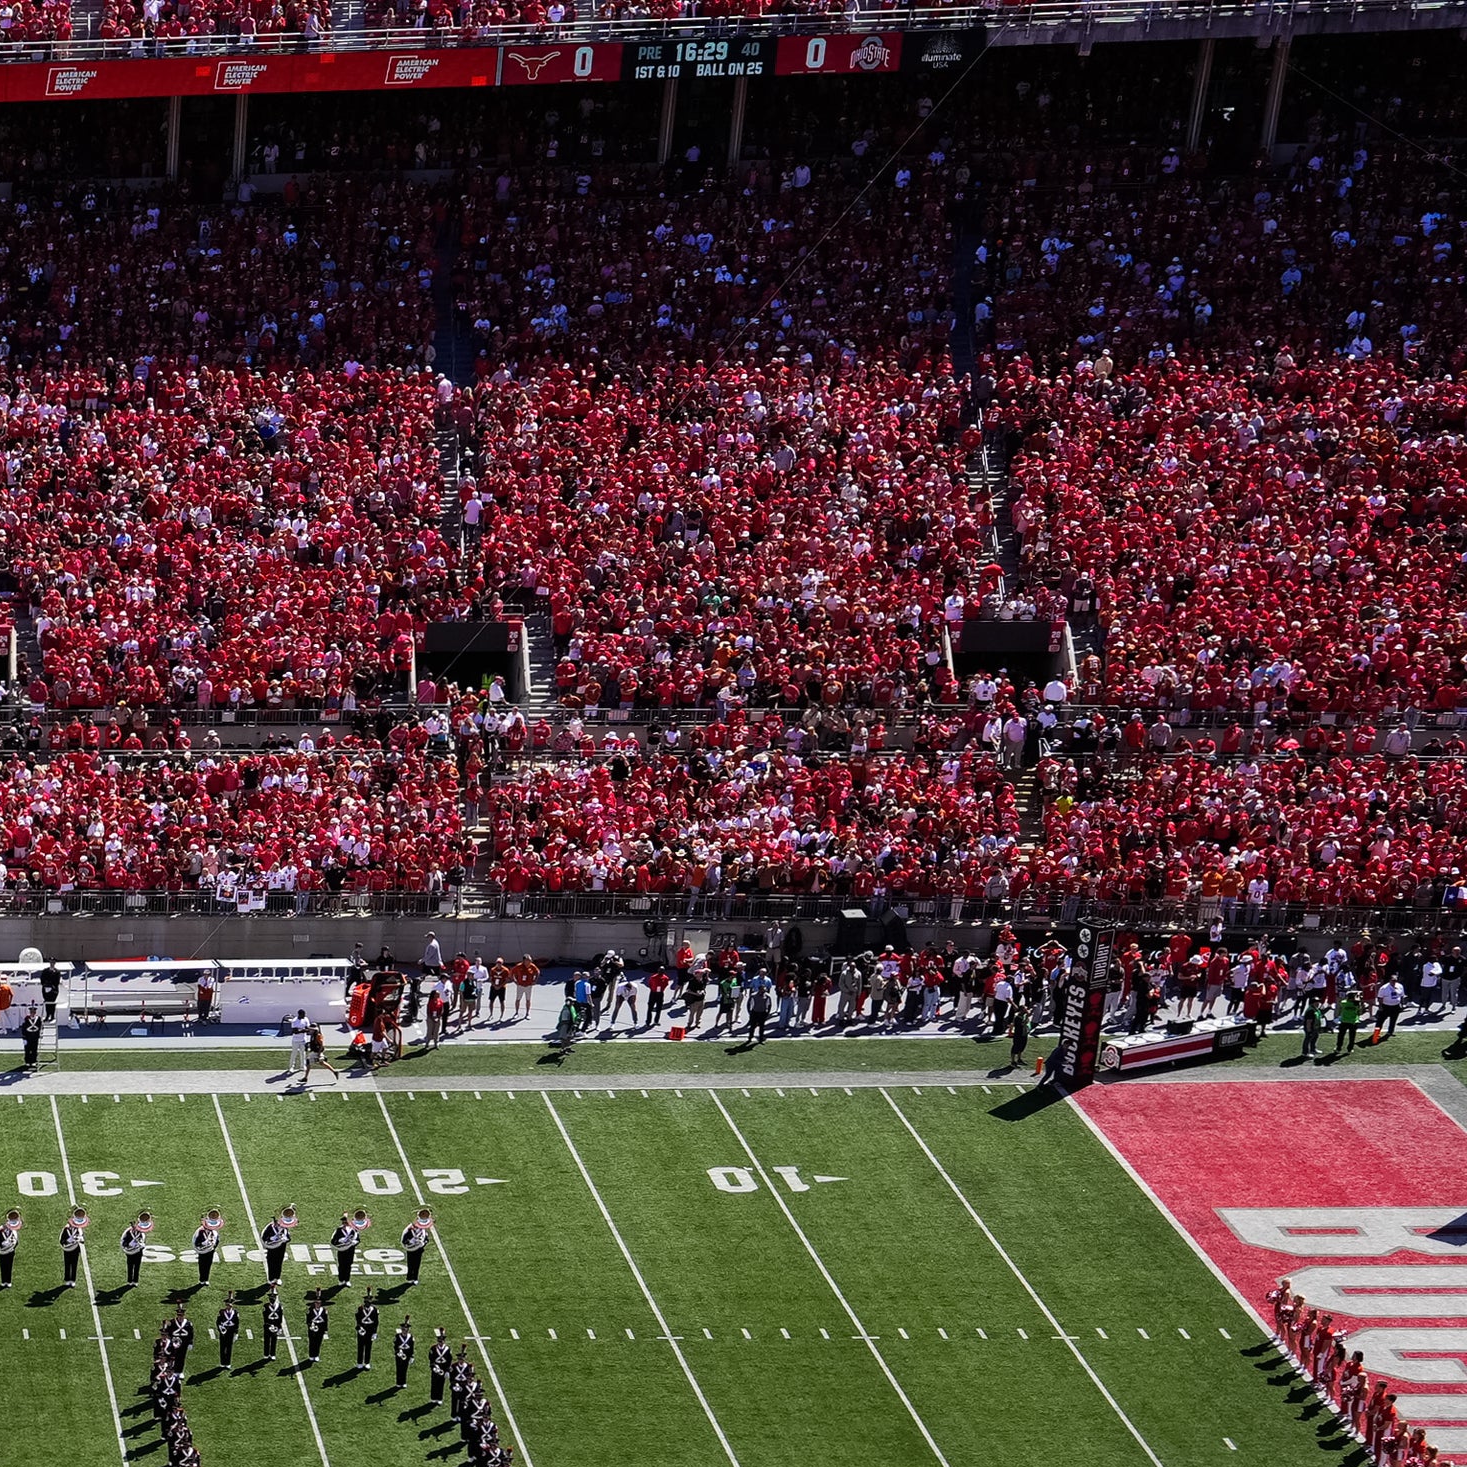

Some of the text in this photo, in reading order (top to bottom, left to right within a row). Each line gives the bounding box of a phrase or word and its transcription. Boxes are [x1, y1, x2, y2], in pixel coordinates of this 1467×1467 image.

[573, 46, 594, 76] 0
[638, 42, 761, 63] PRE 16:29 40
[805, 37, 826, 68] 0
[635, 64, 654, 80] 1ST
[667, 64, 681, 79] 10
[696, 62, 722, 77] BALL
[724, 61, 741, 76] ON
[743, 60, 764, 75] 25
[1093, 943, 1111, 980] weber
